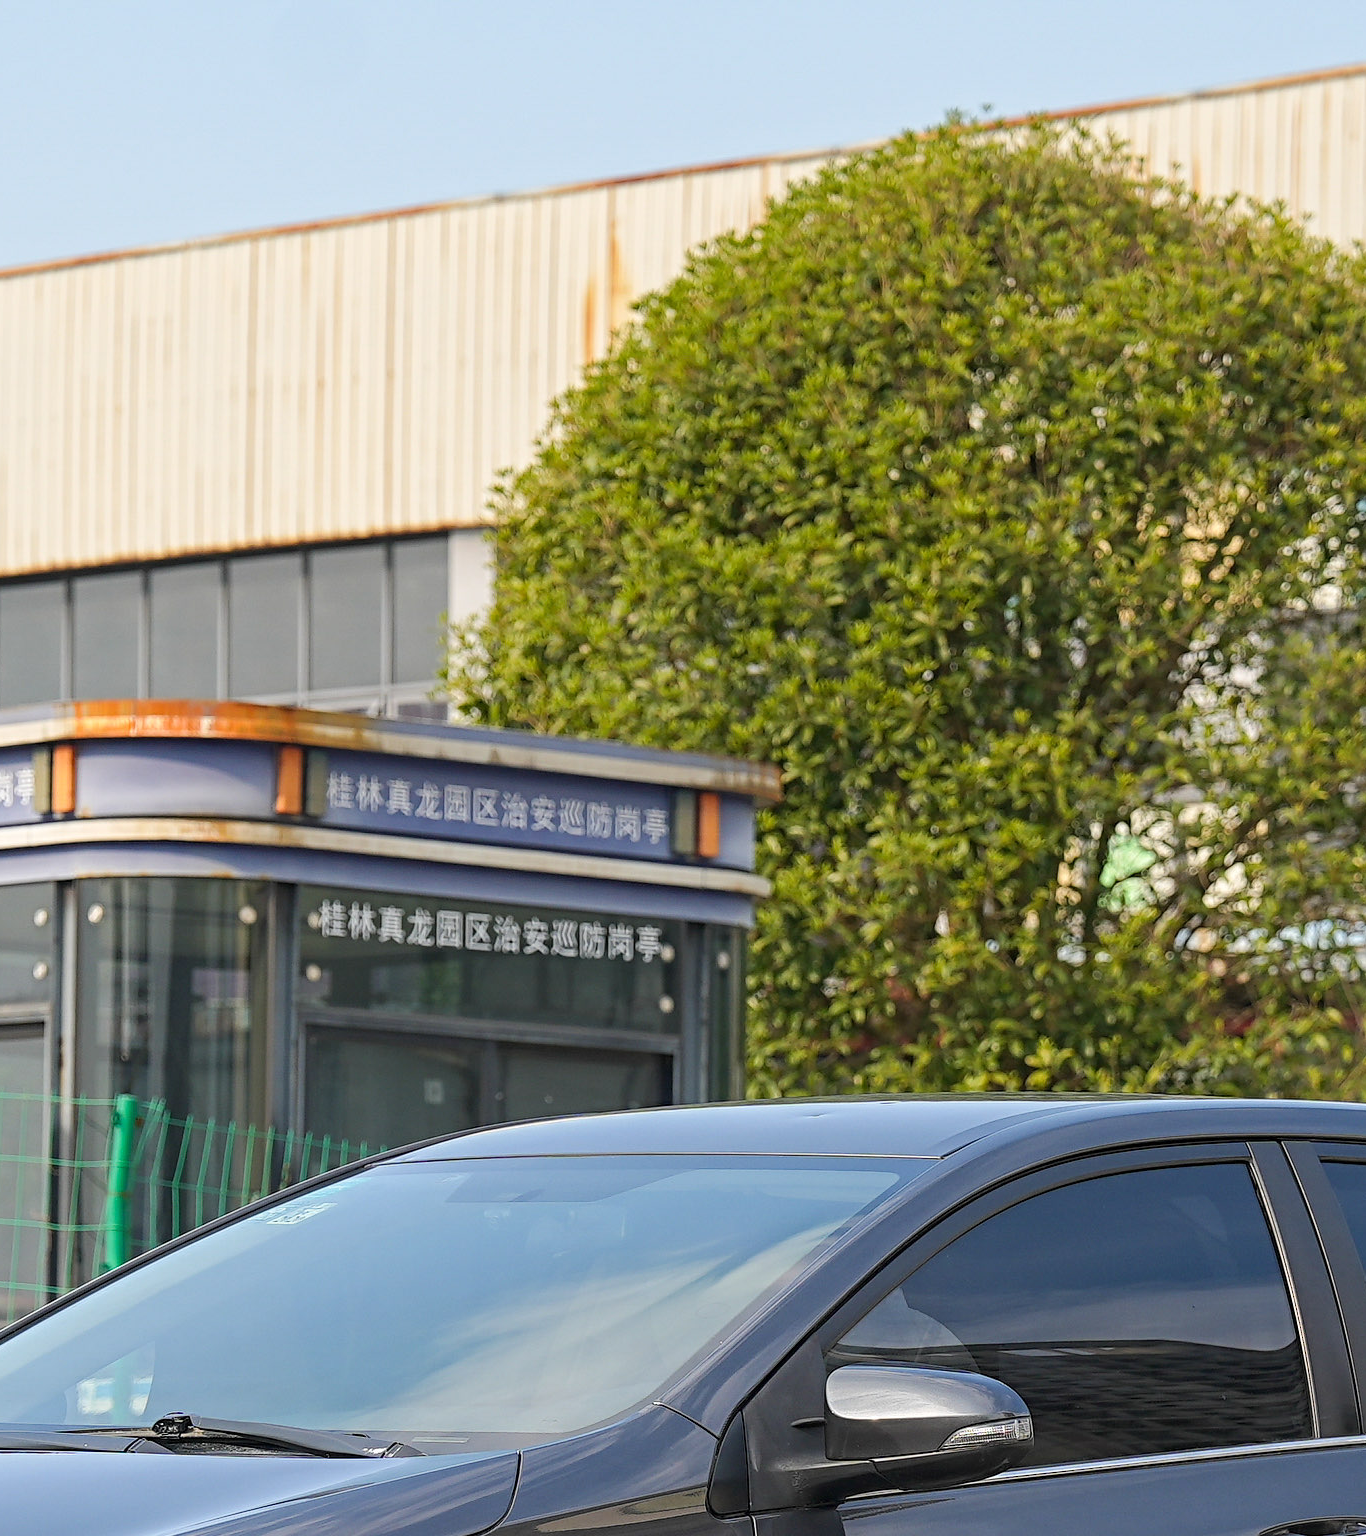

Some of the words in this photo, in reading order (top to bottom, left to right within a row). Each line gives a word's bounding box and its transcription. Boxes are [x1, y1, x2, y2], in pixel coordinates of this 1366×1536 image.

[326, 771, 670, 845] 桂林真龙园区治安巡防岗亭
[318, 899, 664, 963] 桂林真龙园区治安巡防岗亭
